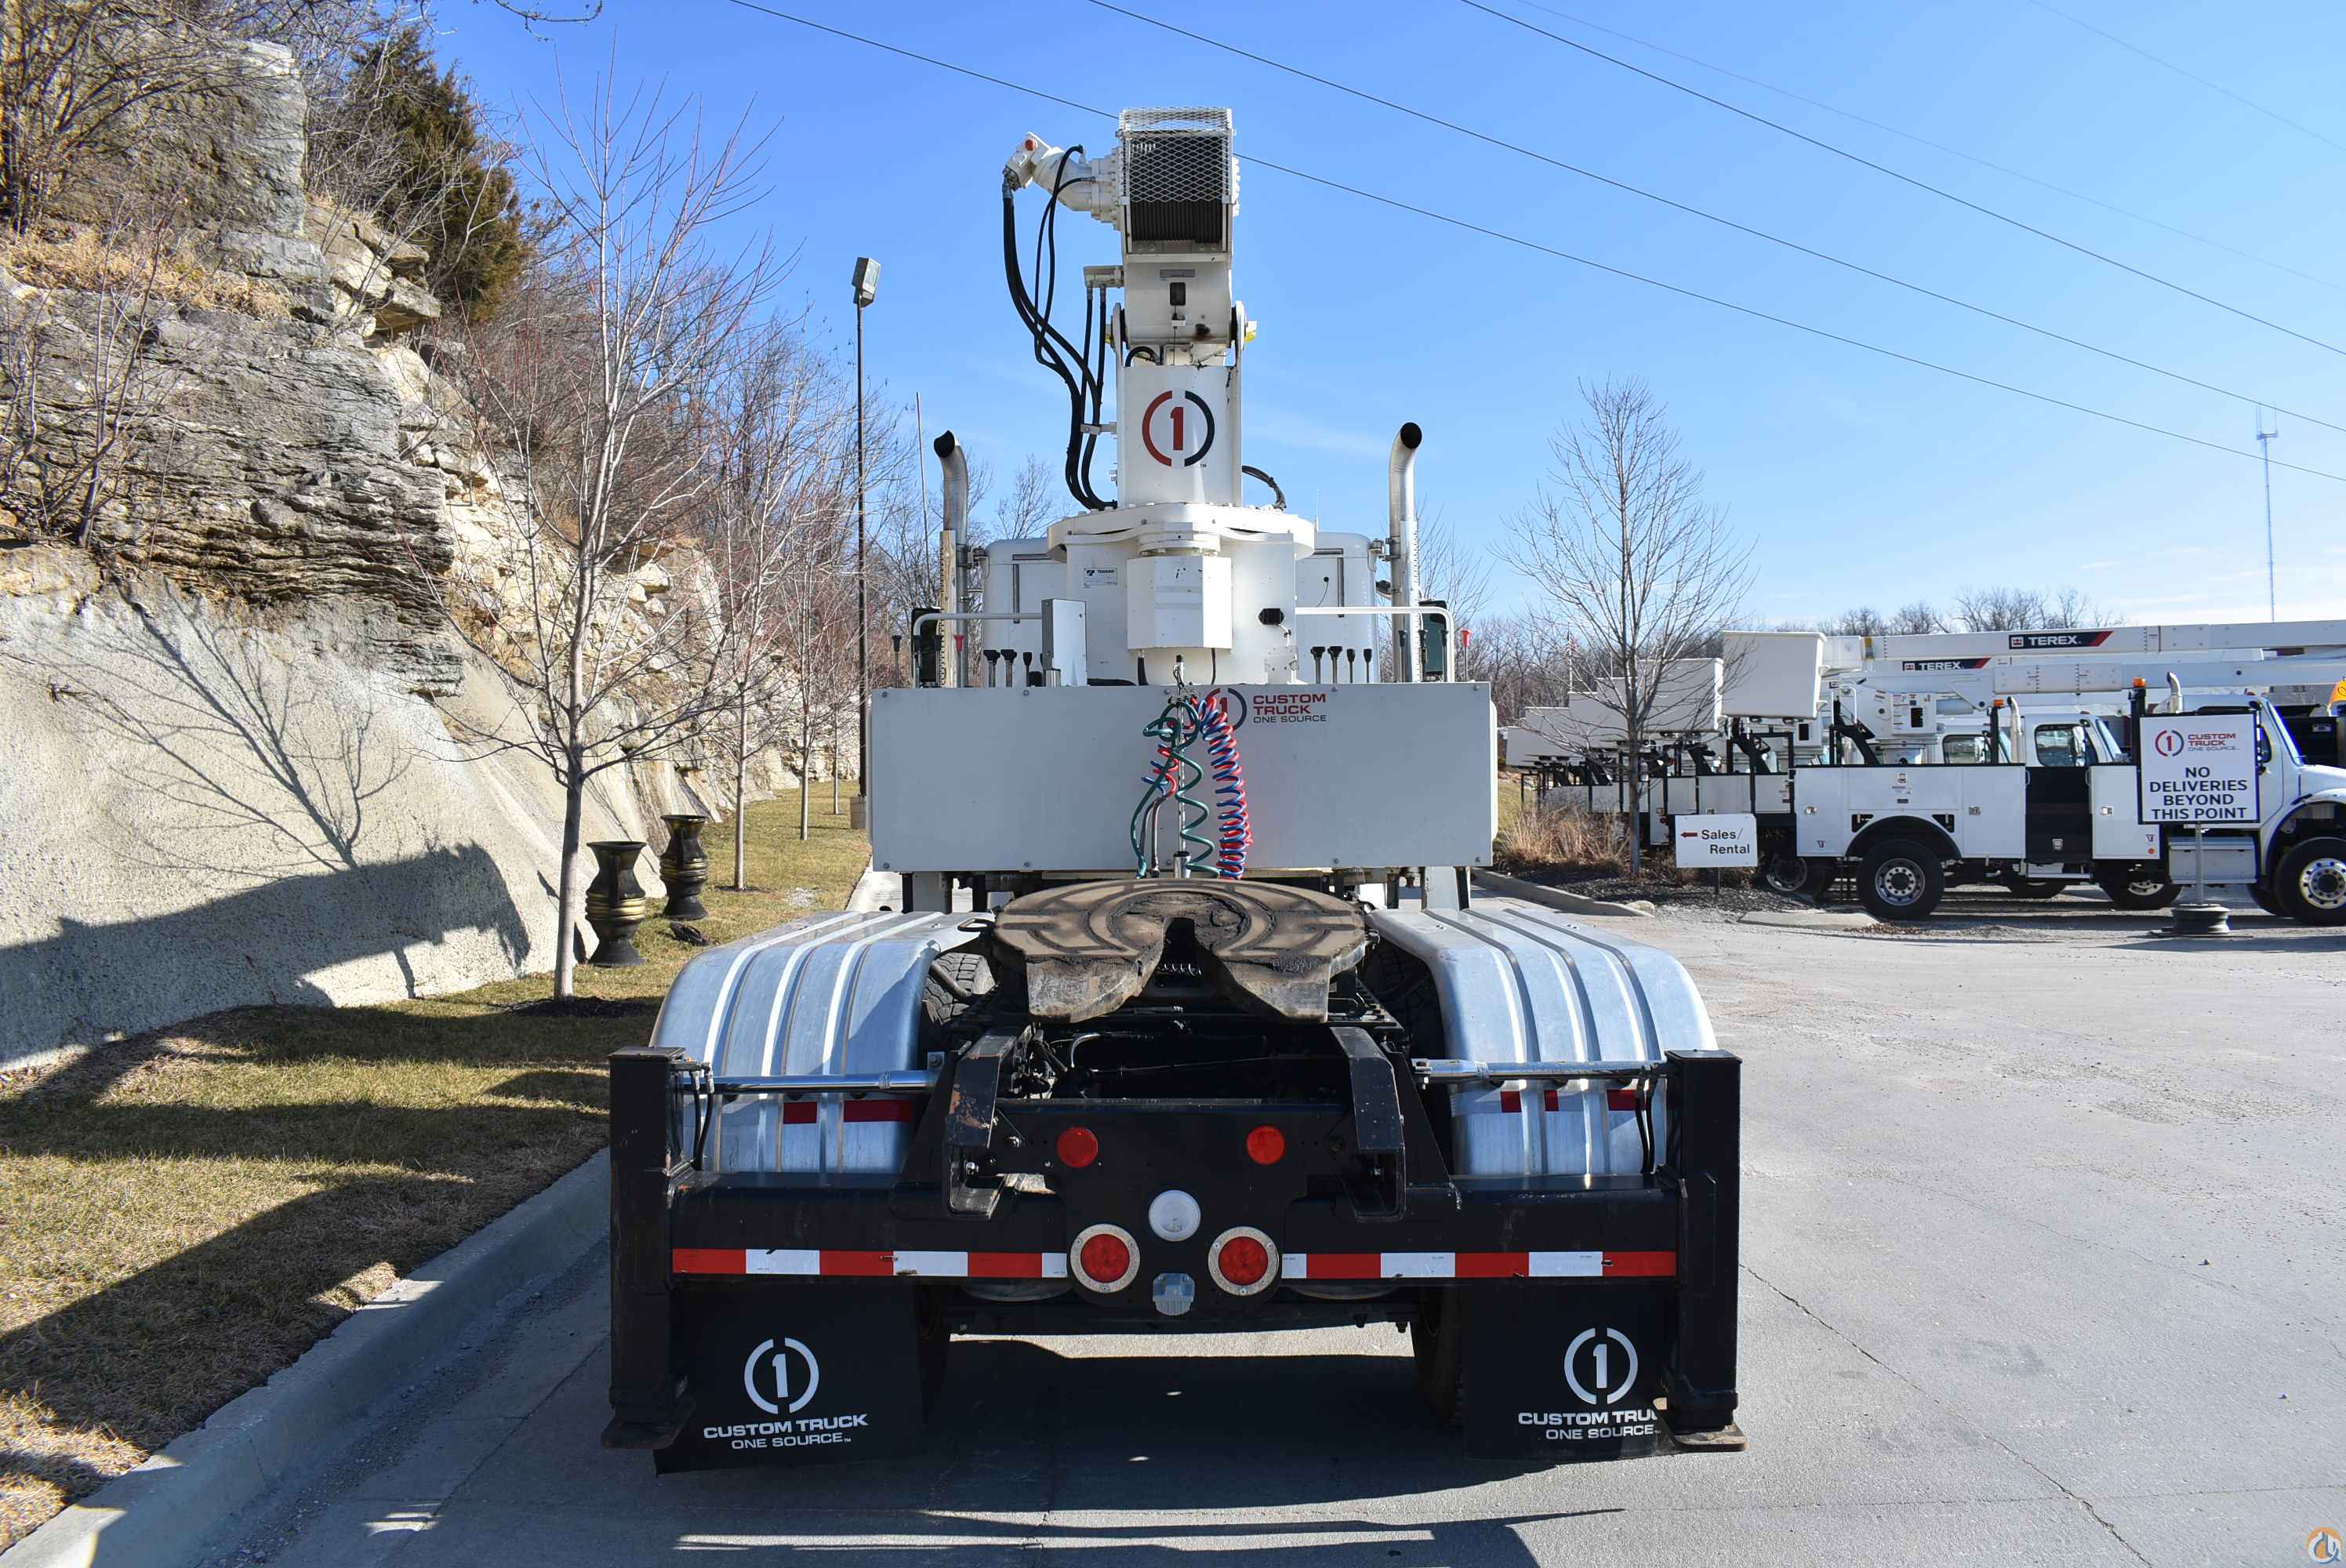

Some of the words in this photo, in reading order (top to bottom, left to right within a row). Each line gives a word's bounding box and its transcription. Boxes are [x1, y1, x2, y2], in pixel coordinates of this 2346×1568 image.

[1170, 406, 1184, 451] 1
[2028, 635, 2081, 646] TEREX
[1919, 661, 1961, 671] TEREX
[1253, 694, 1326, 704] CUSTOM
[1253, 705, 1310, 715] TRUCK
[2185, 768, 2210, 778] NO
[2150, 780, 2247, 793] DELIVERIES
[2163, 794, 2234, 806] BEYOND
[2152, 808, 2189, 820] THIS
[2195, 807, 2247, 819] POINT
[1701, 828, 1744, 840] Sales/
[1709, 844, 1750, 854] Rental
[1518, 1411, 1608, 1425] CUSTOM
[1611, 1409, 1658, 1423] TRU
[703, 1421, 792, 1439] CUSTOM
[795, 1413, 869, 1433] TRUCK
[1545, 1428, 1583, 1439] ONE
[1587, 1424, 1654, 1439] SOURCE
[731, 1438, 768, 1450] ONE
[772, 1432, 843, 1447] SOURCE
